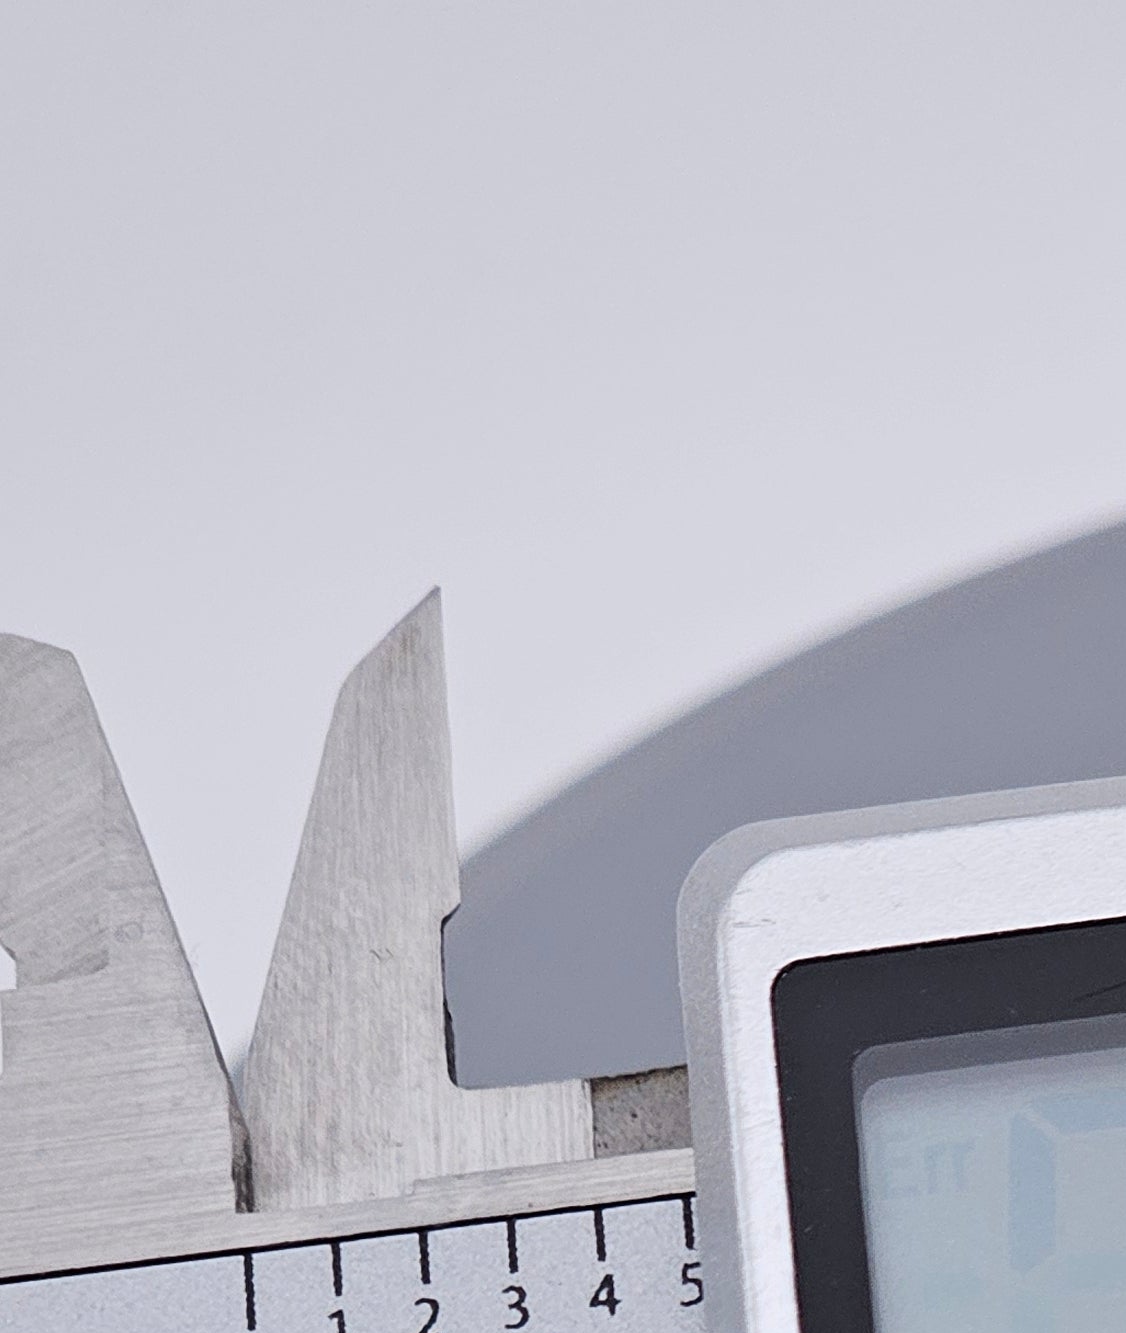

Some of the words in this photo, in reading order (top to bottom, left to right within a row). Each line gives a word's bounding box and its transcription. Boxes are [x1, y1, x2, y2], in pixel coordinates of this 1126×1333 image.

[503, 1286, 530, 1330] 3
[589, 1274, 622, 1316] 4
[680, 1261, 705, 1307] 5
